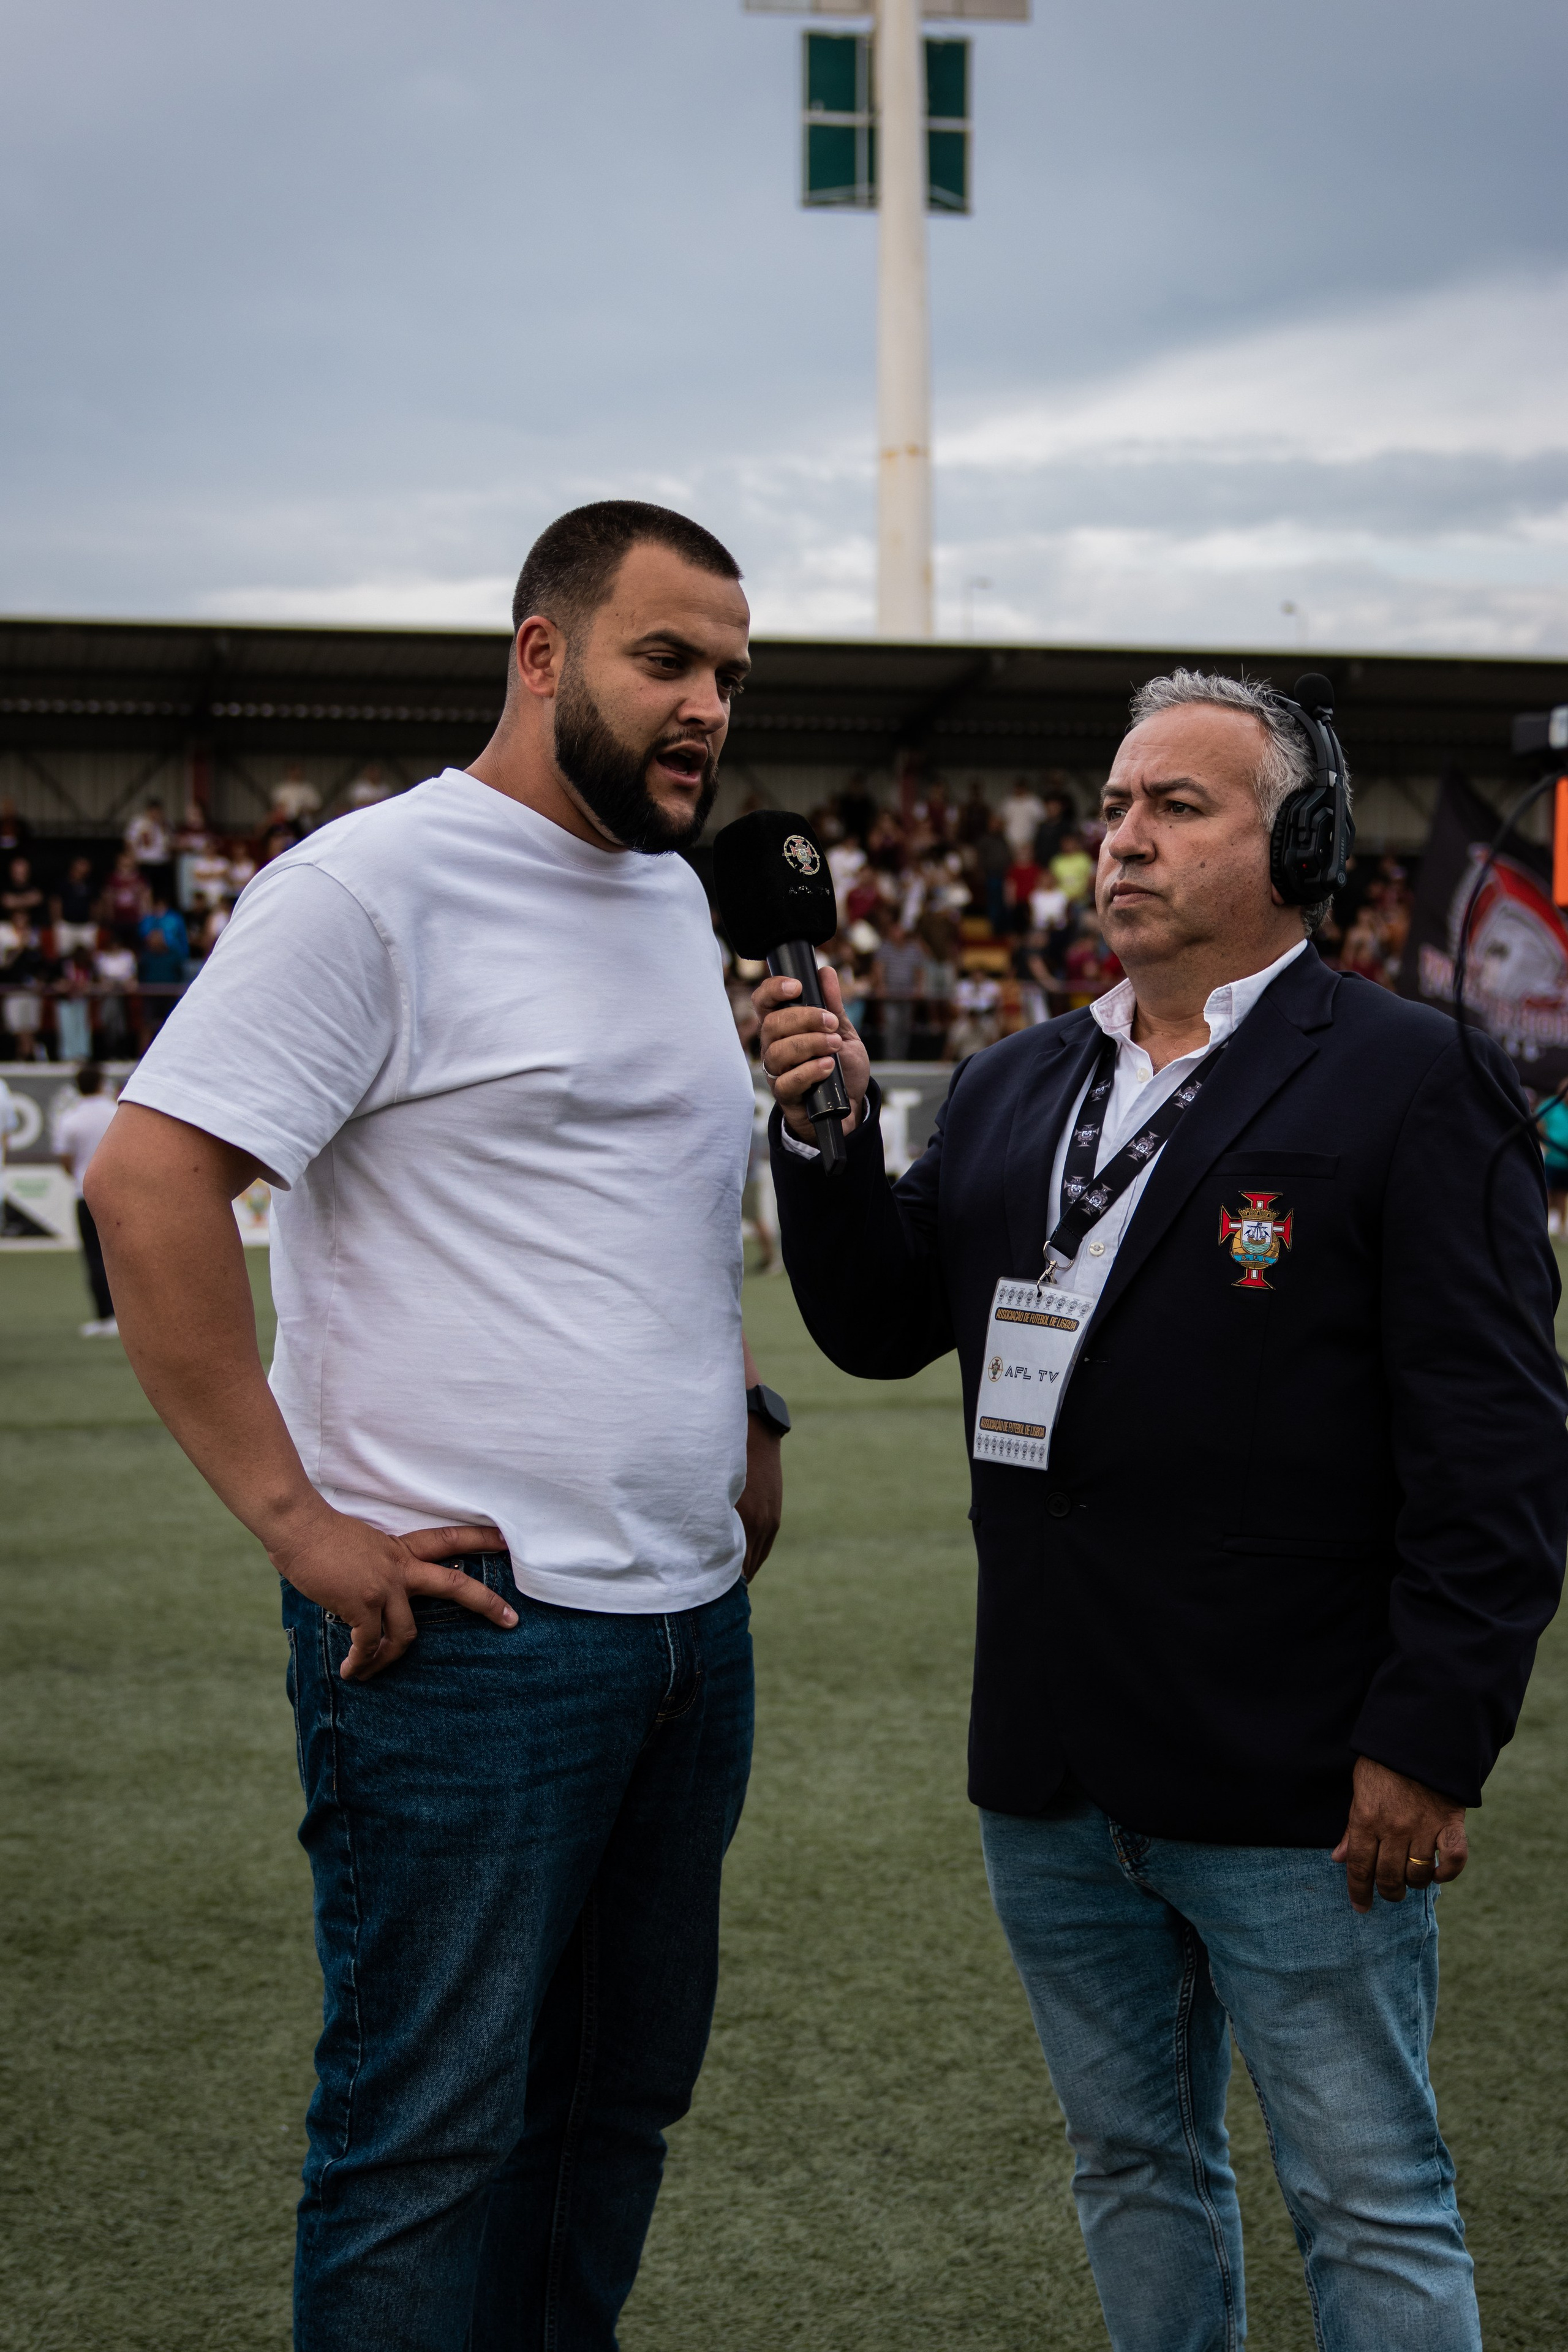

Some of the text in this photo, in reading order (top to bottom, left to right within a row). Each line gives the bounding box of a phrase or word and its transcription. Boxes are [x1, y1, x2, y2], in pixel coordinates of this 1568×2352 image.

[996, 1309, 1077, 1330] ASSOCIAÇÃO DE FUTEBOL DE LISBOA
[1005, 1365, 1060, 1384] AFL TV
[980, 1418, 1045, 1438] ASSOCIAÇÃO DE FUTEBOL DE LISBOA
